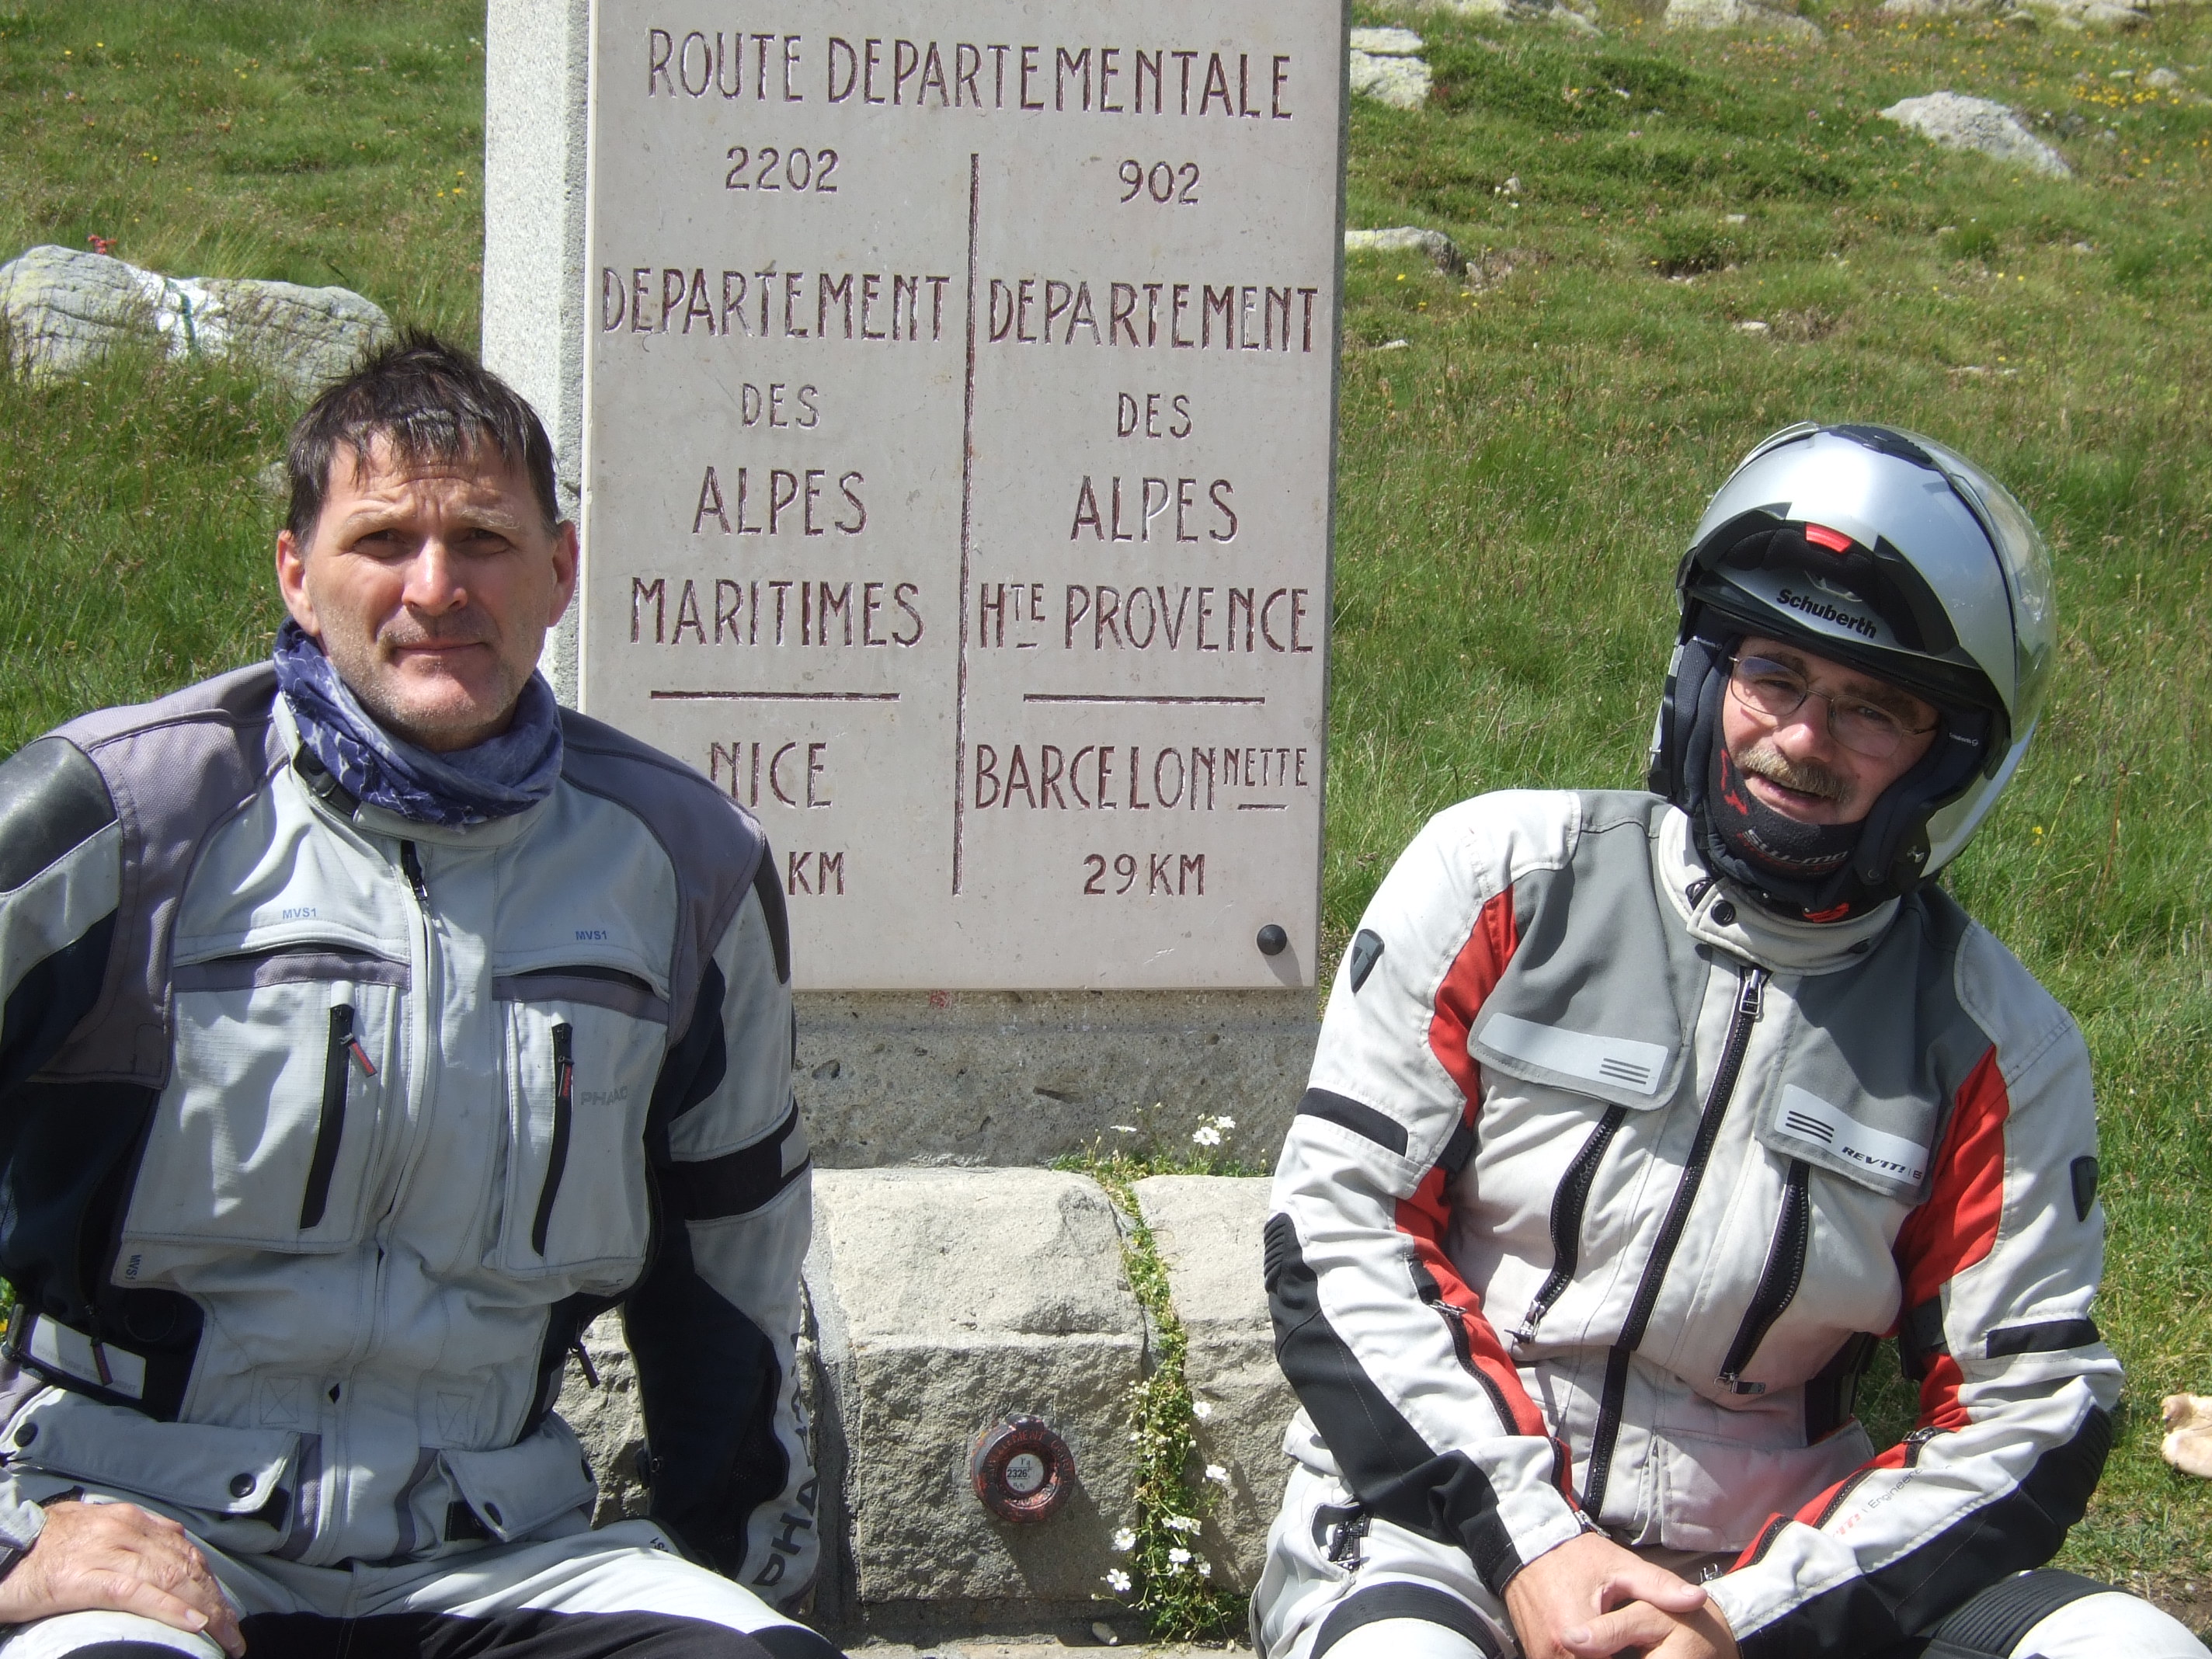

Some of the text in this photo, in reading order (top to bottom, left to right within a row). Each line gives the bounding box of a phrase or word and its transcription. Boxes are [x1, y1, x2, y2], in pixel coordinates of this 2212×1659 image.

[648, 28, 1294, 121] ROUTE DEPARTEMENTALE
[725, 145, 840, 194] 2202
[1118, 159, 1201, 206] 902
[601, 267, 951, 342] DEPARTEMENT
[988, 278, 1319, 353] DEPARTEMENT
[741, 382, 820, 429] DES
[1117, 392, 1194, 440] DES
[692, 465, 868, 537] ALPES
[1070, 475, 1240, 544] ALPES
[630, 576, 926, 649] MARITIMES
[1064, 585, 1315, 654] PROVENCE
[1776, 588, 1877, 639] Schuberth
[710, 742, 832, 809] NICE
[788, 850, 845, 897] KM
[282, 907, 317, 920] MVS1
[576, 930, 607, 941] MVS1
